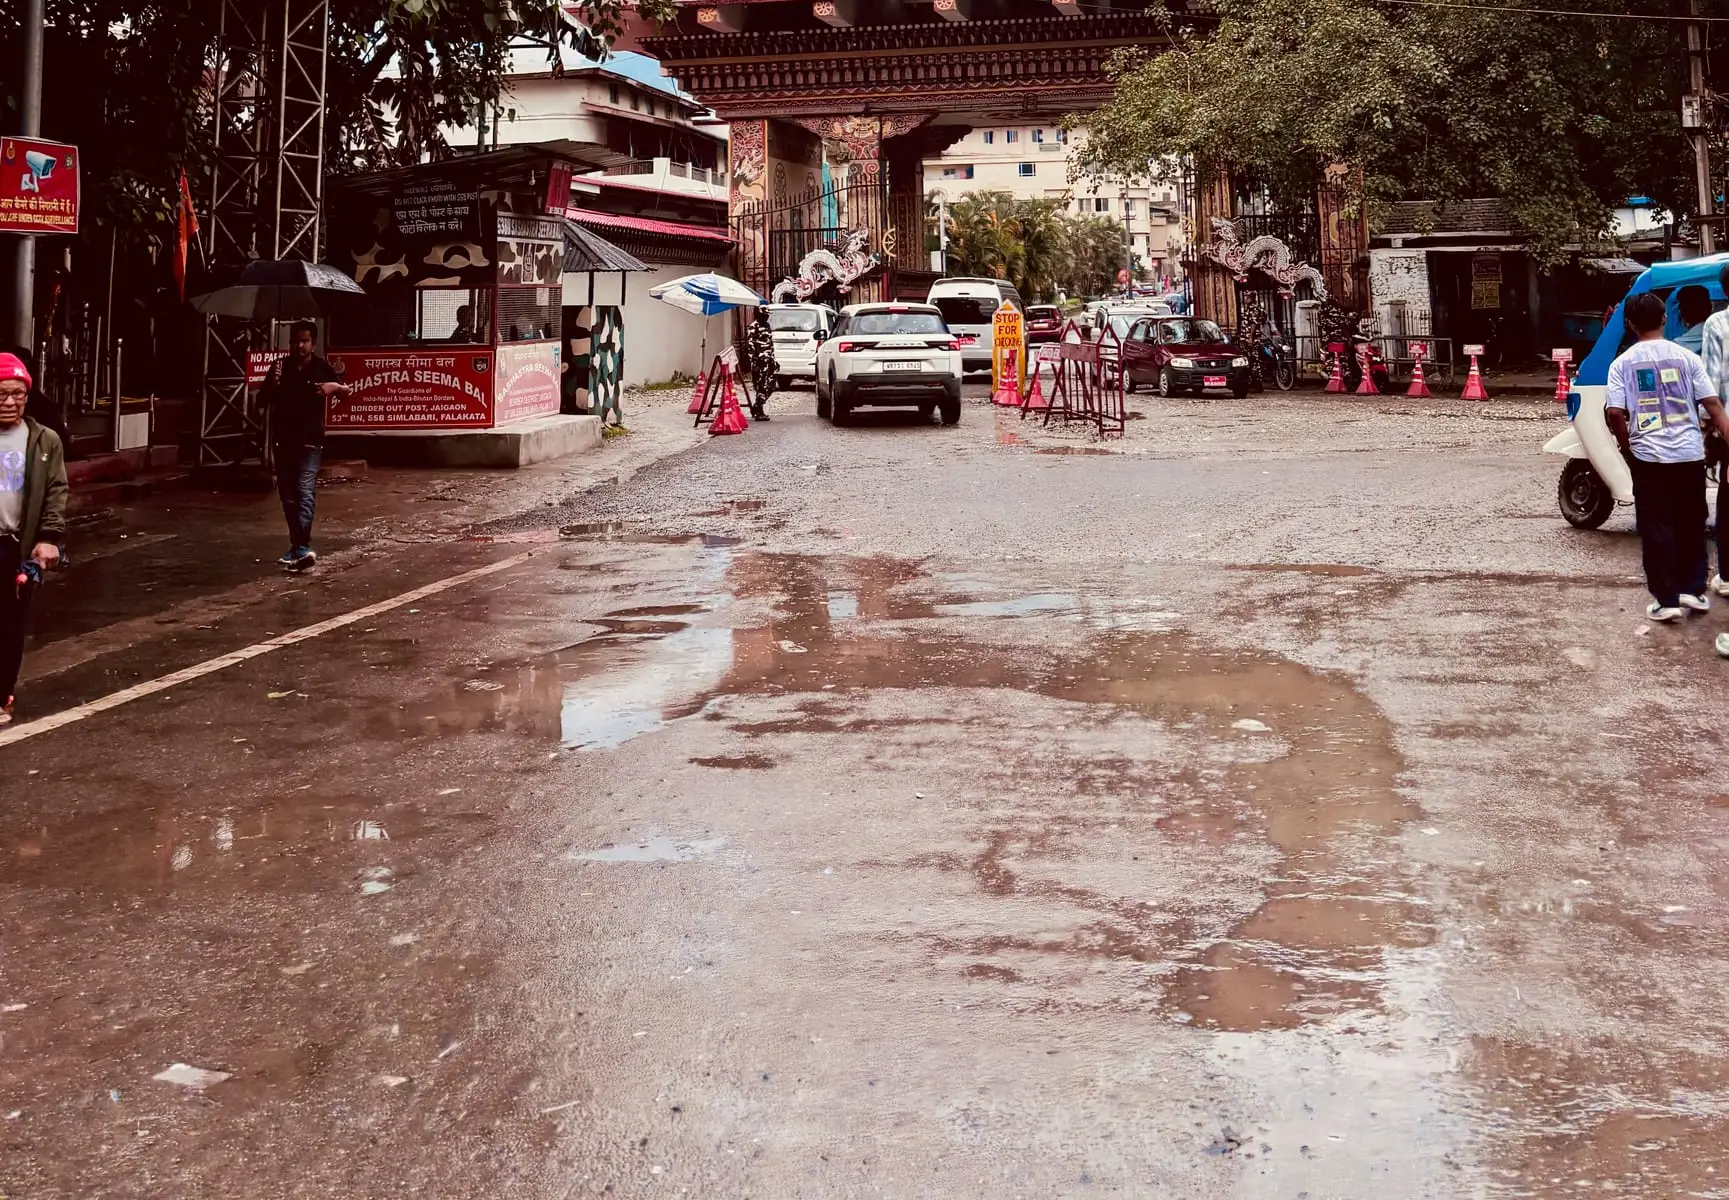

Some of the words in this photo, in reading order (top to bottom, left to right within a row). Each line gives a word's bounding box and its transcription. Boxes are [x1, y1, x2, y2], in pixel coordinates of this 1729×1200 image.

[438, 221, 446, 231] न
[995, 313, 1019, 323] STOP
[998, 325, 1017, 335] FOR
[250, 353, 262, 363] NO
[405, 354, 433, 369] सीमा
[414, 370, 461, 390] SEEMA
[464, 380, 488, 409] BAL
[386, 404, 403, 412] OUT
[405, 404, 429, 413] POST,
[430, 403, 467, 411] JAIGAON
[350, 414, 366, 423] BN,
[367, 414, 384, 422] SSB
[387, 413, 438, 422] SIMLABARI,
[440, 412, 486, 421] FALAKATA
